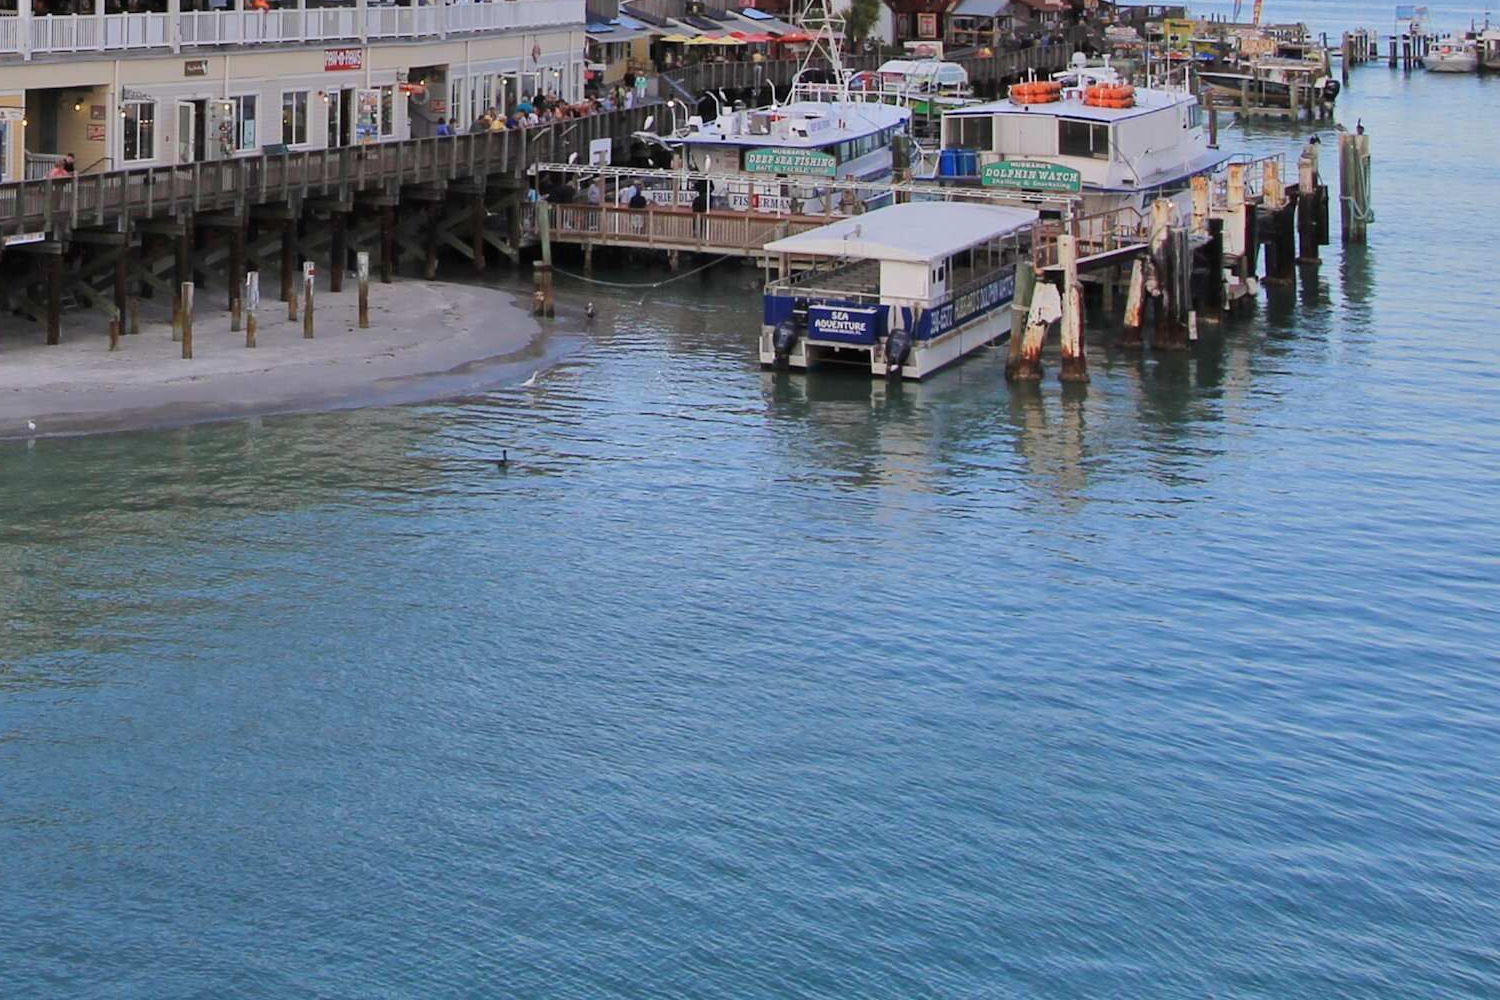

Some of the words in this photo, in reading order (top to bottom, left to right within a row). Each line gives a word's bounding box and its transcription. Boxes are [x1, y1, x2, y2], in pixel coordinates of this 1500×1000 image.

[748, 154, 773, 164] DEEP
[775, 156, 794, 166] SEA
[796, 157, 835, 168] FISHING
[986, 168, 1036, 179] DOLPHIN
[1038, 171, 1078, 182] WATCH
[831, 311, 849, 321] SEA
[815, 319, 866, 331] ADVENTURE
